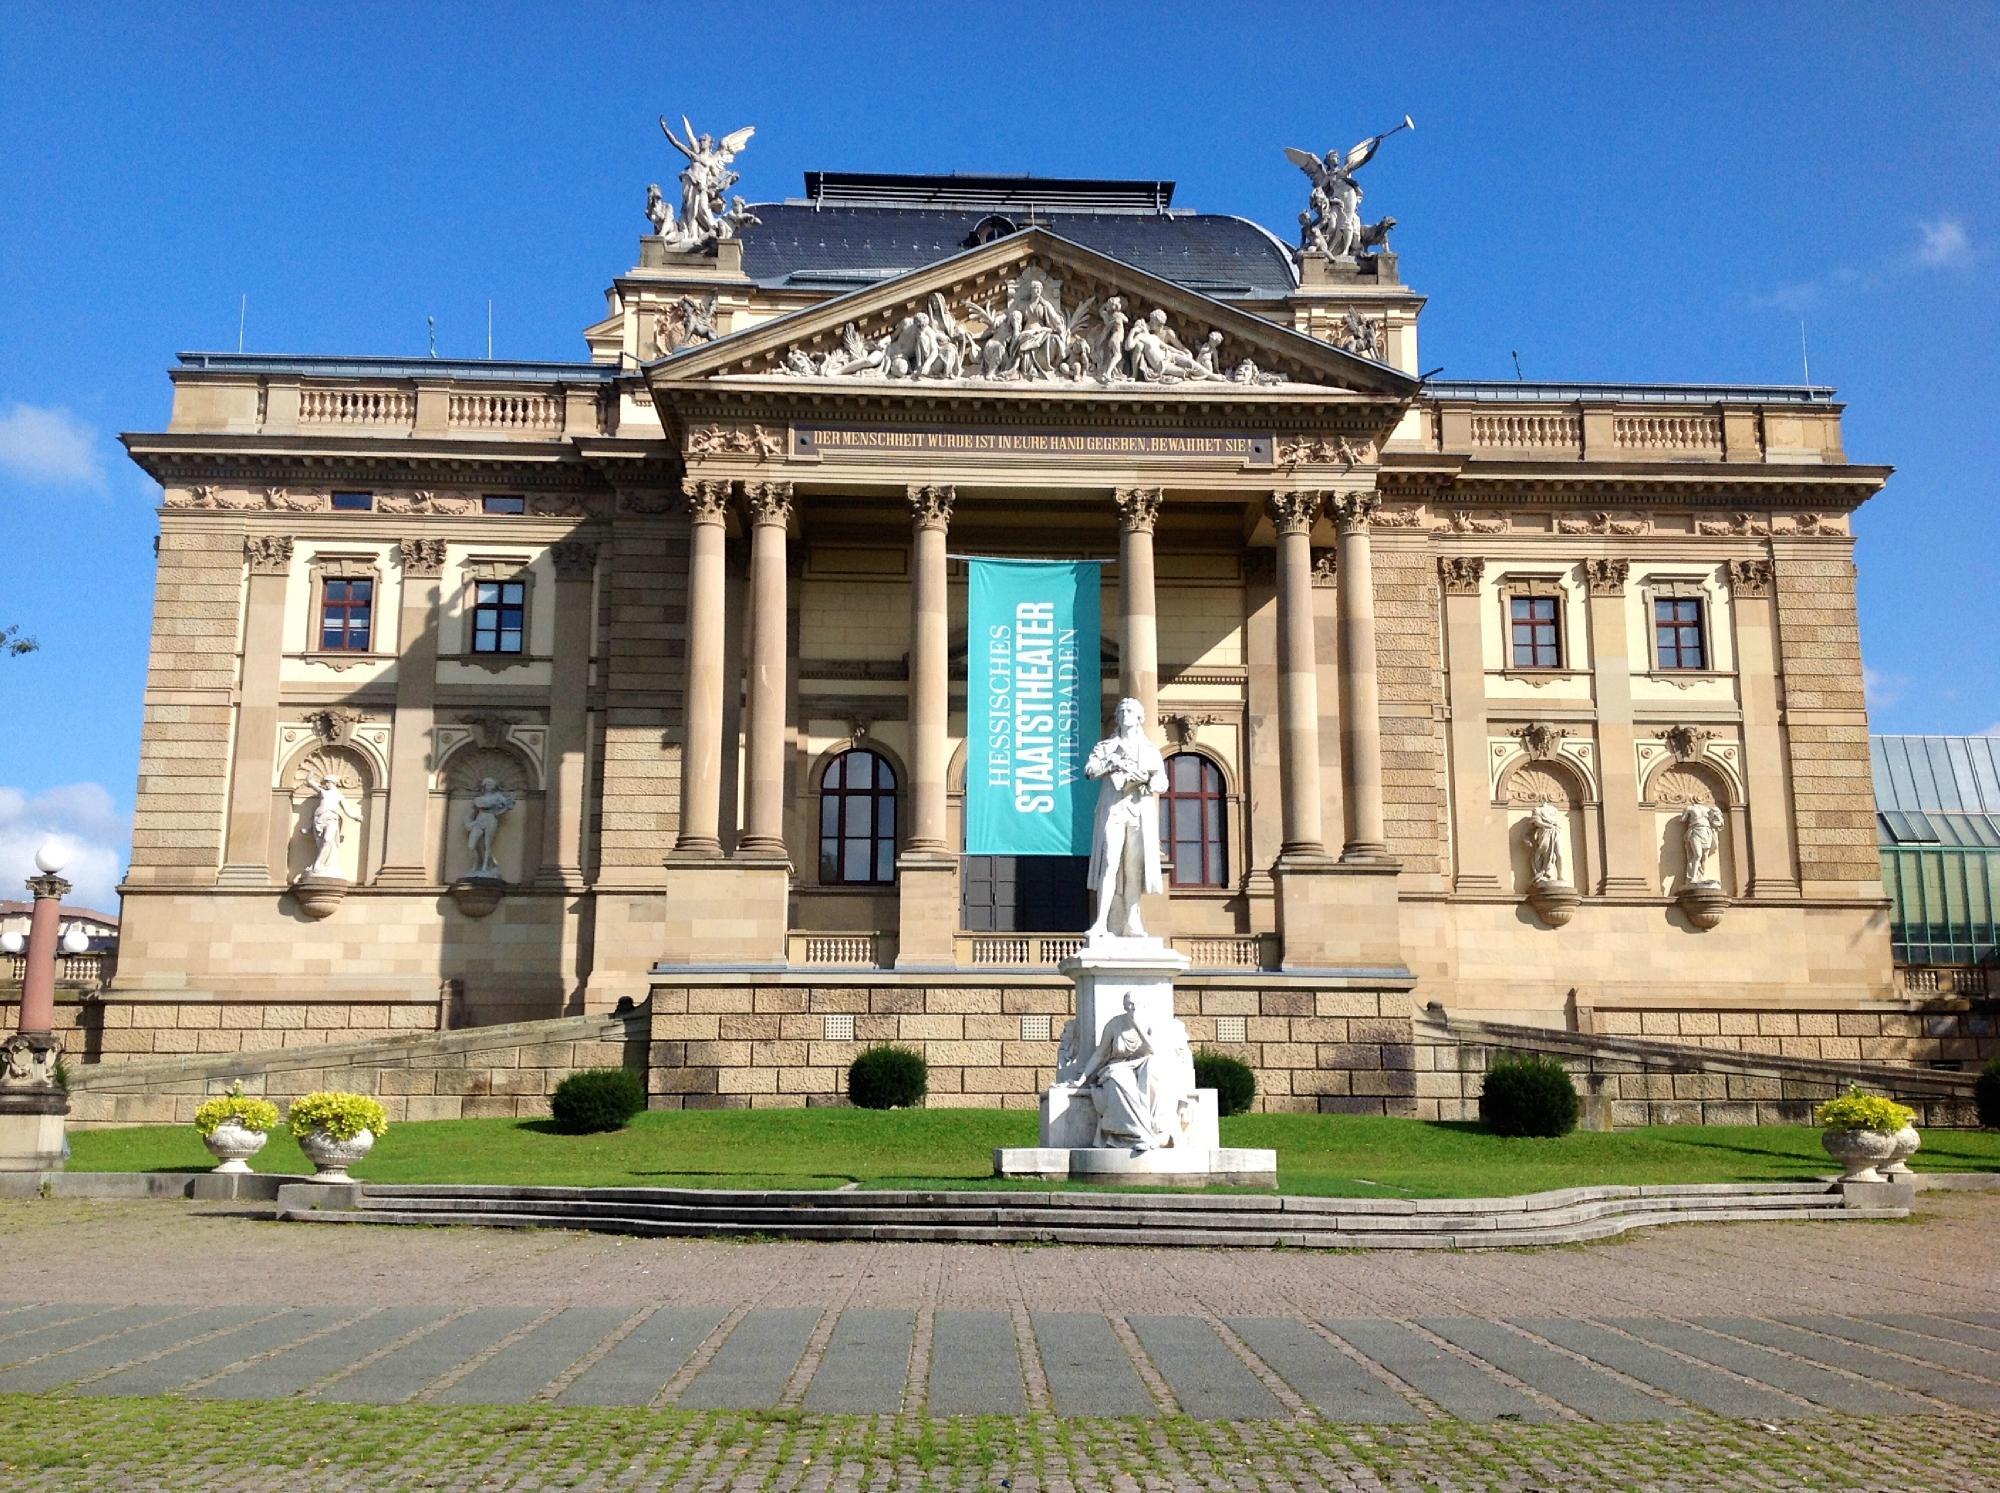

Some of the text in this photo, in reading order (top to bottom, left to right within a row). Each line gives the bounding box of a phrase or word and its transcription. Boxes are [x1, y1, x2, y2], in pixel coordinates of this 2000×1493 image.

[814, 430, 840, 445] DER
[842, 431, 924, 447] MENSCHHEIT
[975, 434, 996, 449] IST
[998, 435, 1011, 449] IN
[1013, 435, 1048, 450] EURE
[1050, 436, 1084, 450] HAND
[1151, 438, 1222, 452] BEWAHRET
[1225, 438, 1252, 452] SIE!
[989, 624, 1011, 788] HESSISCHES
[1015, 601, 1054, 814] STAATSTHEATER
[1058, 627, 1079, 788] WIESBADEN
